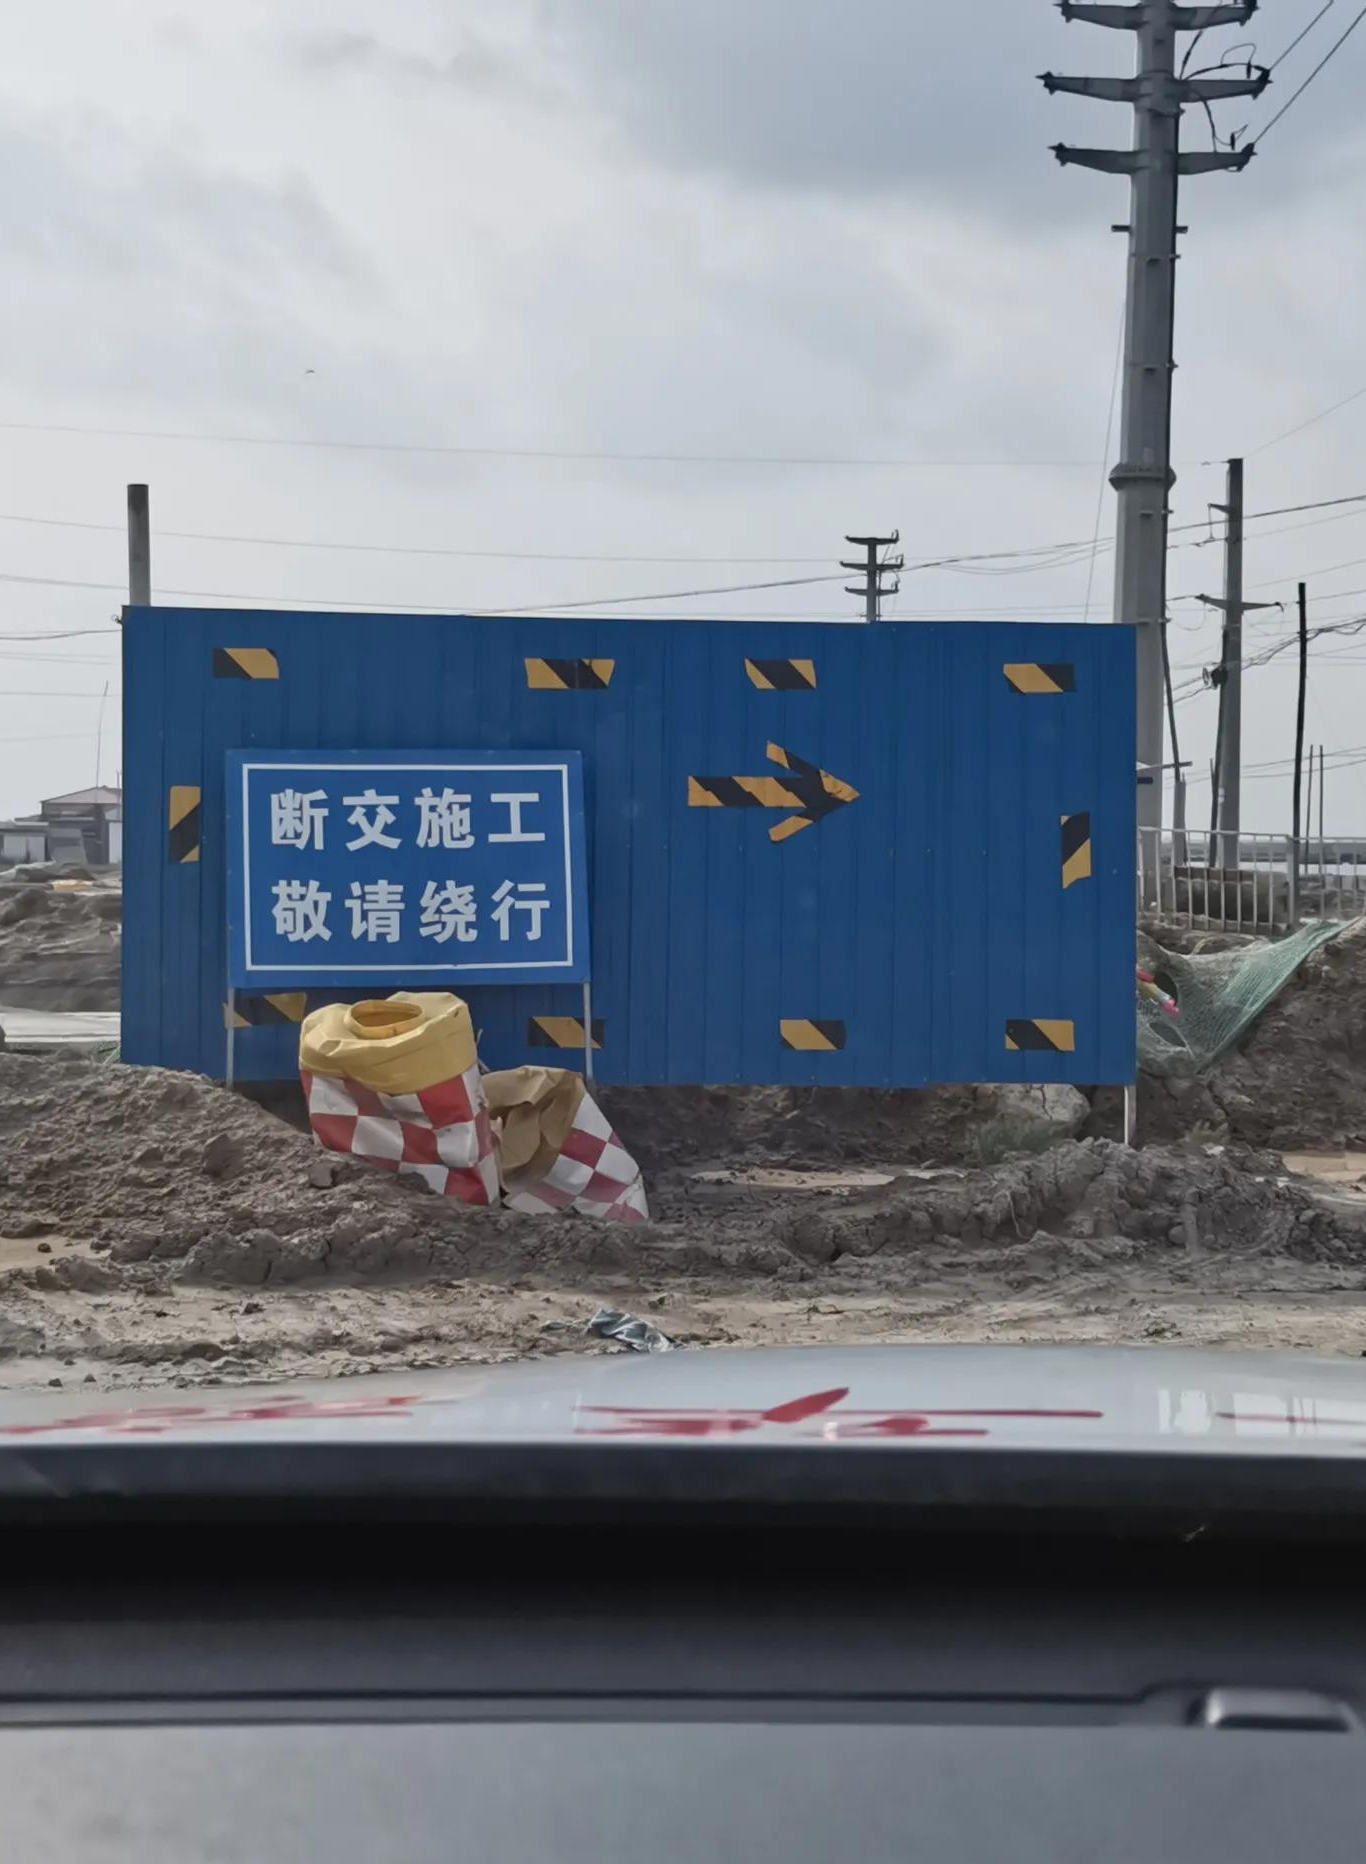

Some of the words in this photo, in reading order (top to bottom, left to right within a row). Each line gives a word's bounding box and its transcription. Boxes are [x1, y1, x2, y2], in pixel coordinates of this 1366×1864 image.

[270, 786, 546, 851] 断交施工
[271, 878, 550, 944] 敬请绕行
